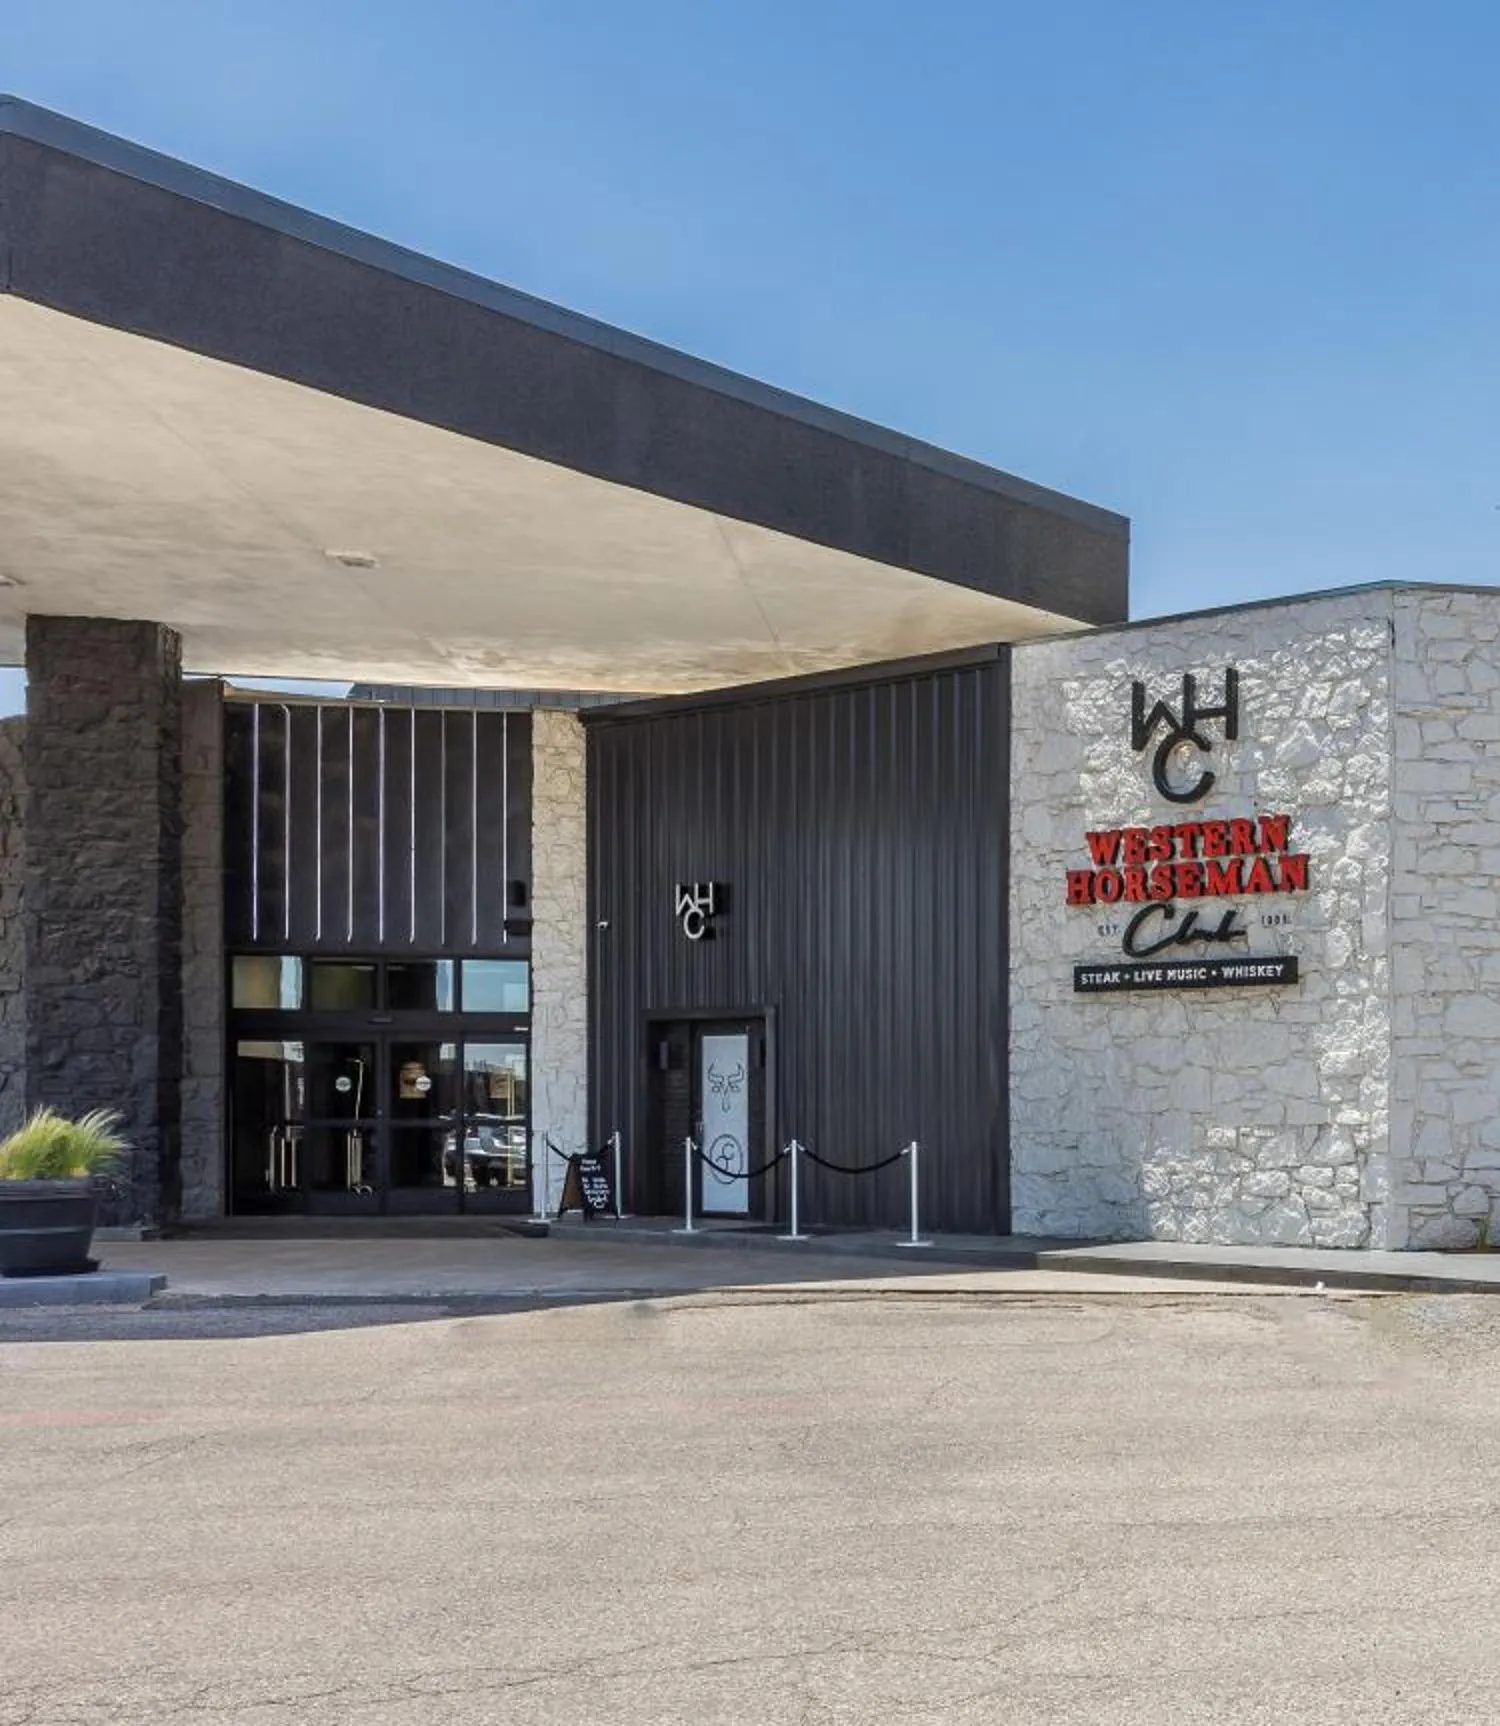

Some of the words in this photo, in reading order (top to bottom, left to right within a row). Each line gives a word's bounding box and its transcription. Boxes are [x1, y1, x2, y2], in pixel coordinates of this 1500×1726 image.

[1086, 815, 1292, 866] WESTERN
[1065, 854, 1311, 905] HORSEMAN
[1122, 903, 1246, 958] Club
[1081, 972, 1121, 985] STEAK
[1133, 969, 1163, 982] LIVE
[1166, 967, 1207, 980] MUSIC
[1222, 964, 1285, 979] WHISKEY
